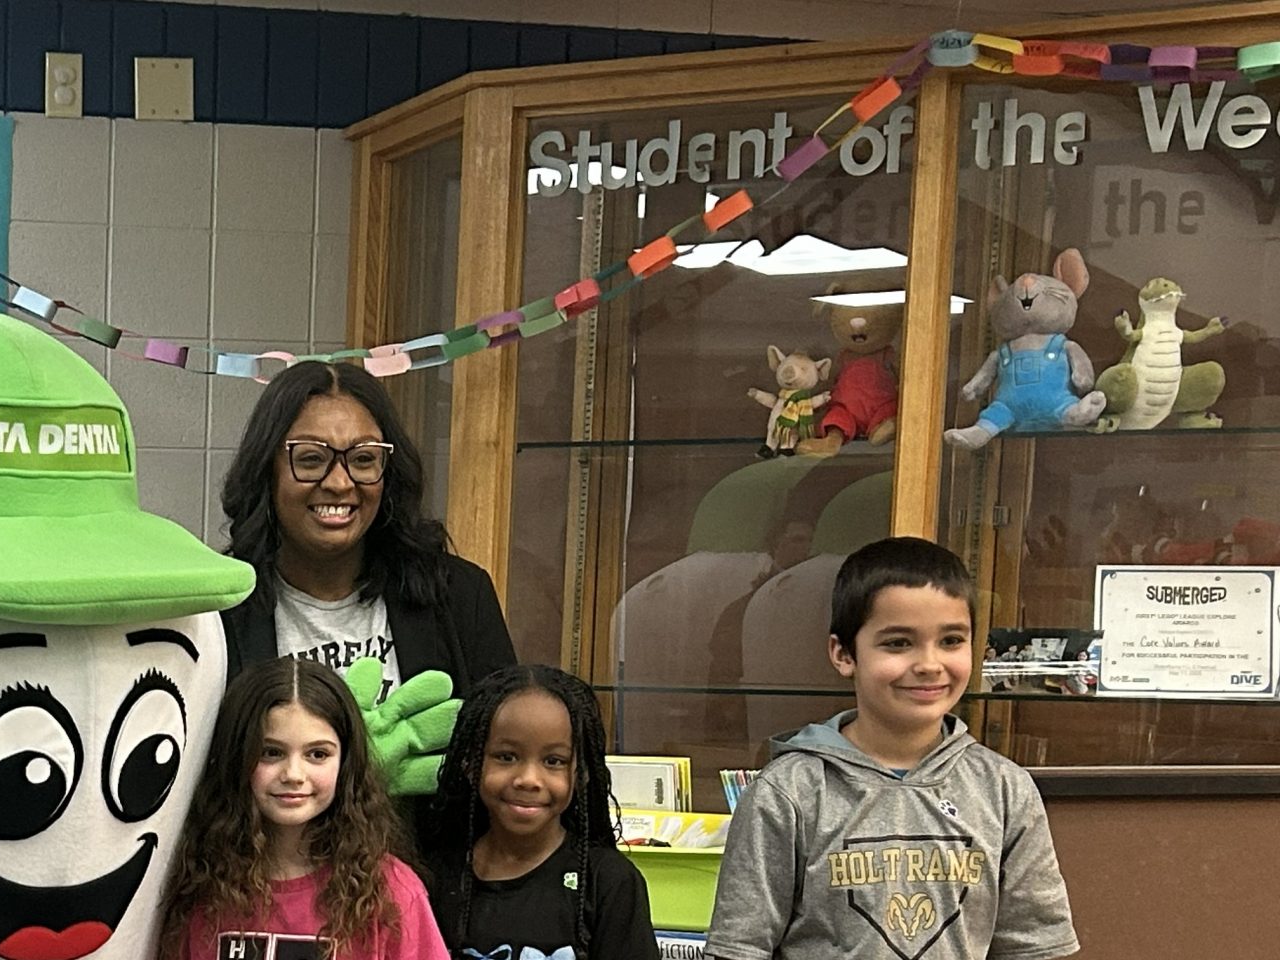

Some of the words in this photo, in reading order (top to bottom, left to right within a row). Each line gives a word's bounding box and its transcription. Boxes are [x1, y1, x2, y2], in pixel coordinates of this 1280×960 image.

[530, 112, 793, 197] Student
[840, 106, 914, 176] of
[971, 98, 1087, 170] the
[1138, 80, 1280, 153] We
[38, 423, 121, 455] DENTAL
[1146, 585, 1227, 605] SUBMERGED
[1230, 675, 1263, 686] DIVE
[828, 846, 901, 887] HOLT
[905, 848, 986, 886] RAMS
